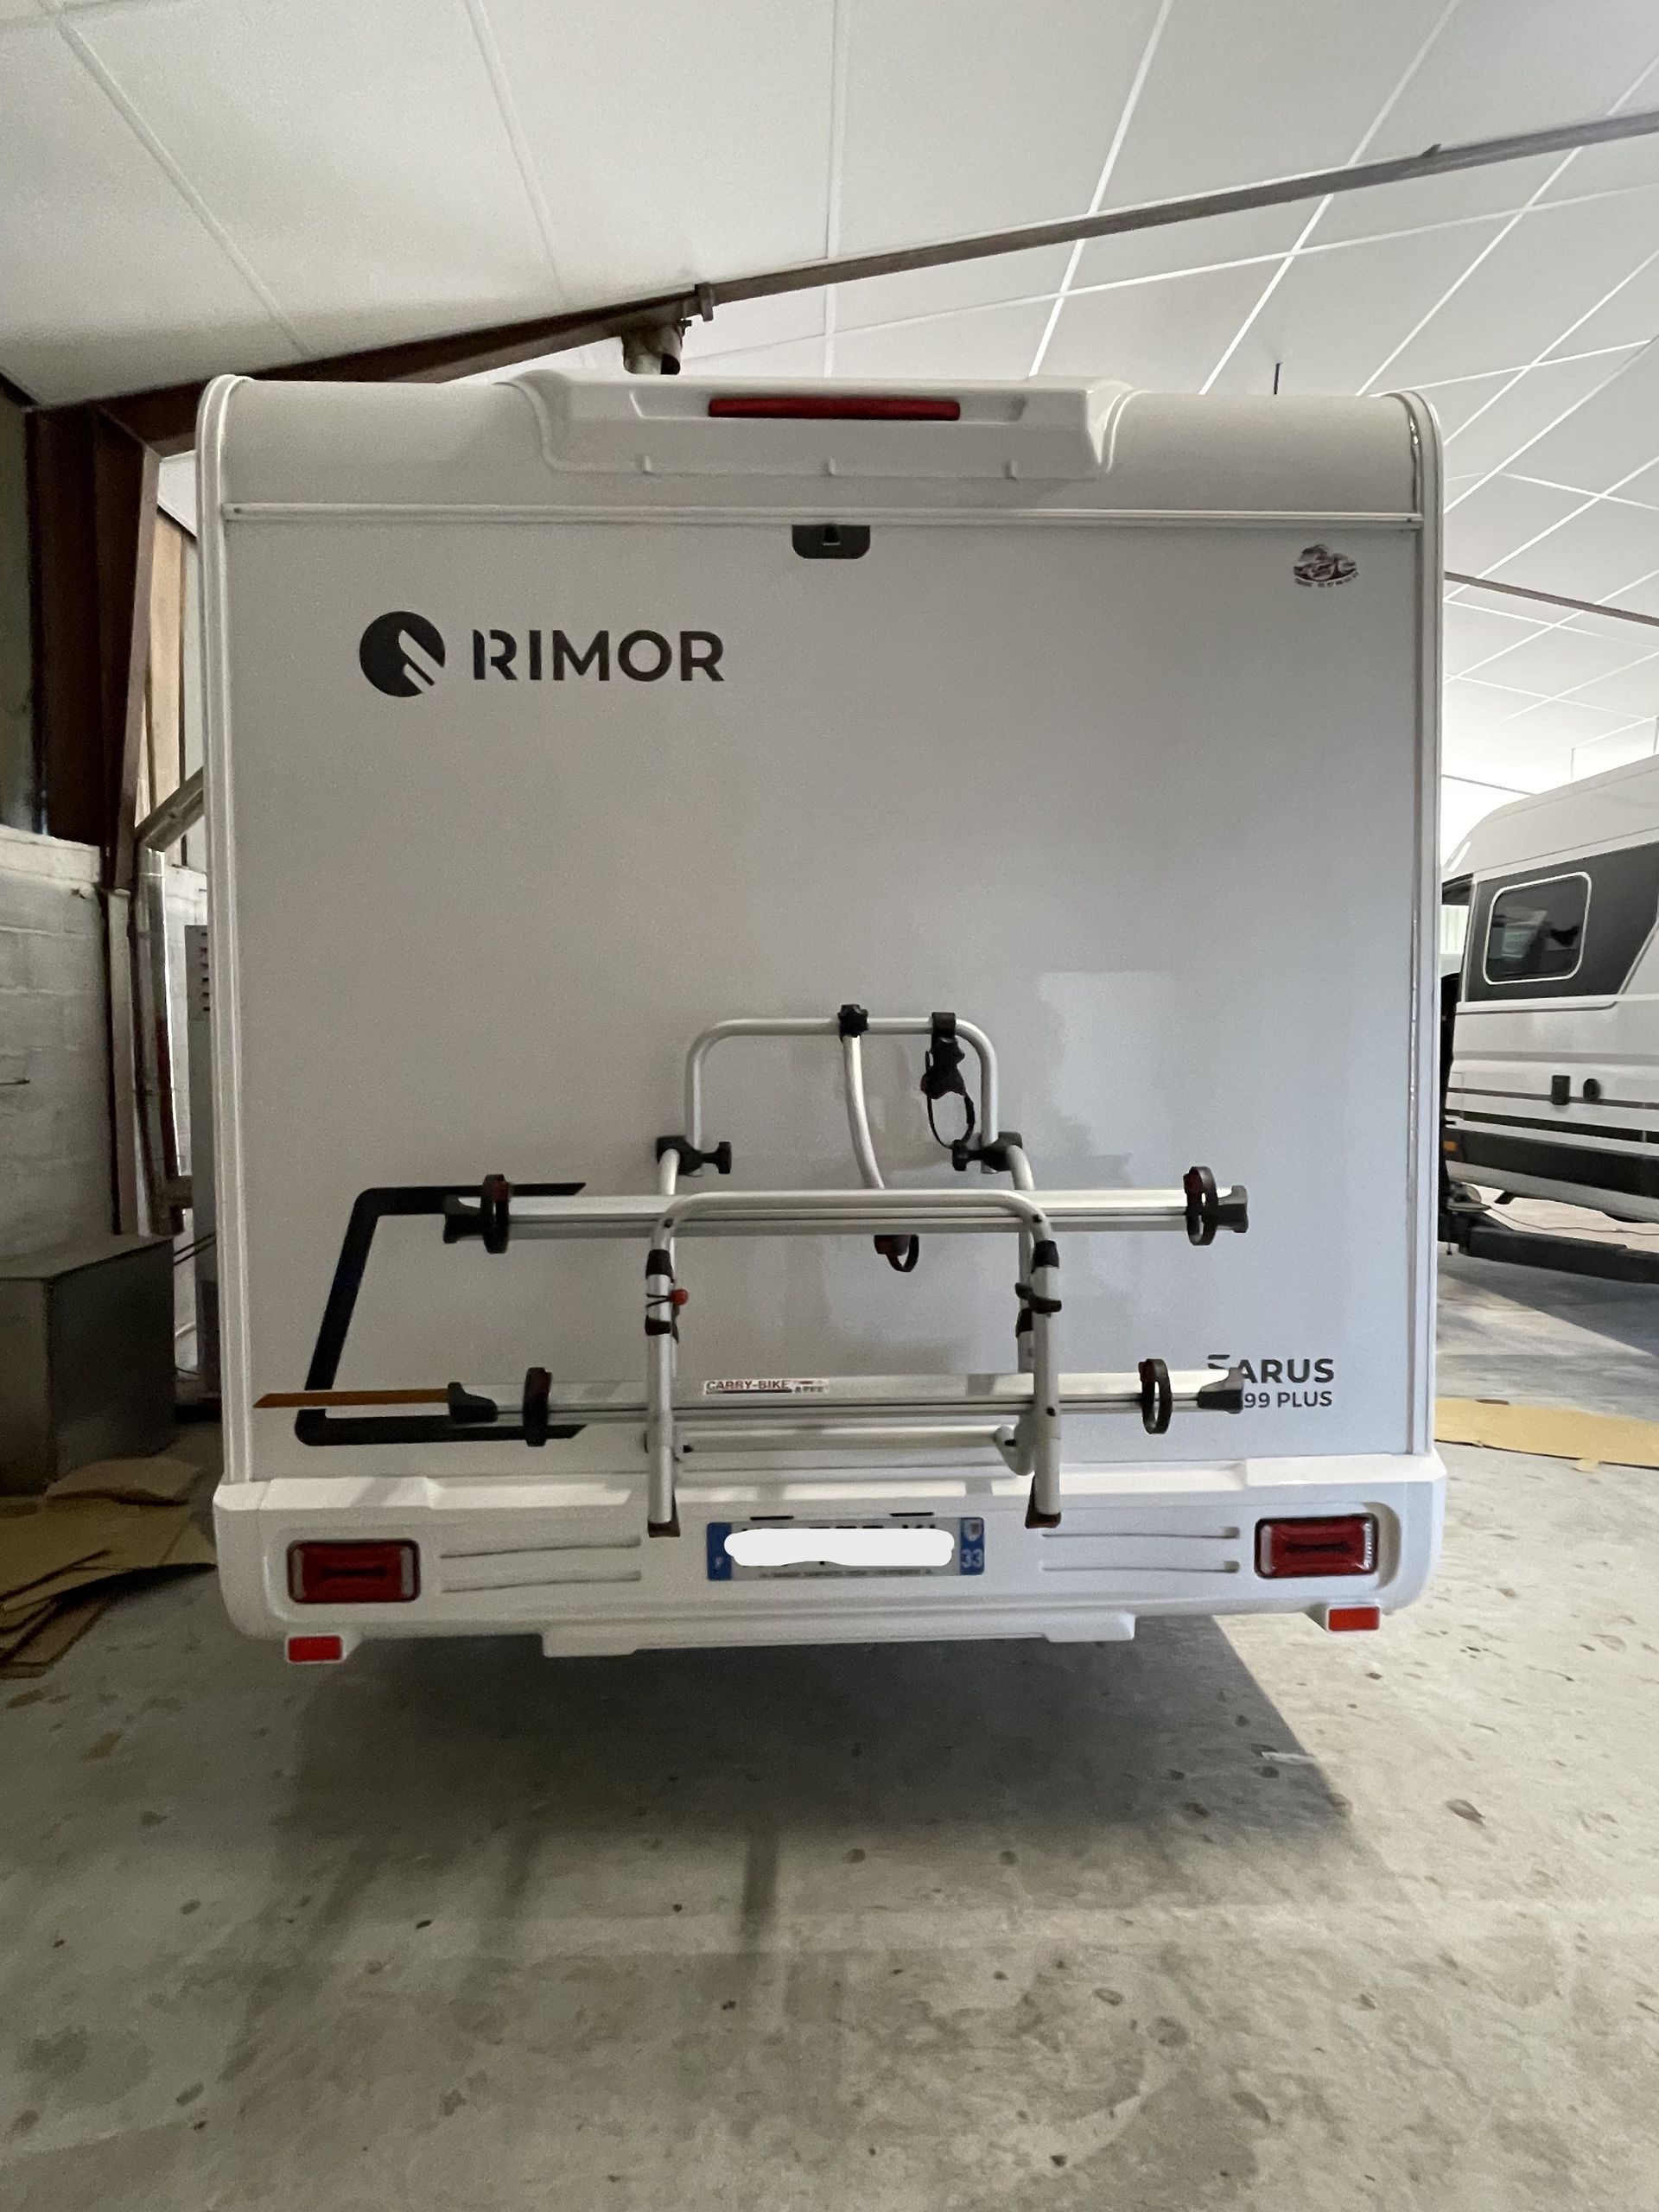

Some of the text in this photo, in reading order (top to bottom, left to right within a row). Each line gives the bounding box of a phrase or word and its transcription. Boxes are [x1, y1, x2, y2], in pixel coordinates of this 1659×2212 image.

[473, 629, 724, 681] RIMOR
[706, 1380, 789, 1390] CARRY-BIKE
[1277, 1391, 1332, 1408] PLUS
[961, 1548, 983, 1568] 33
